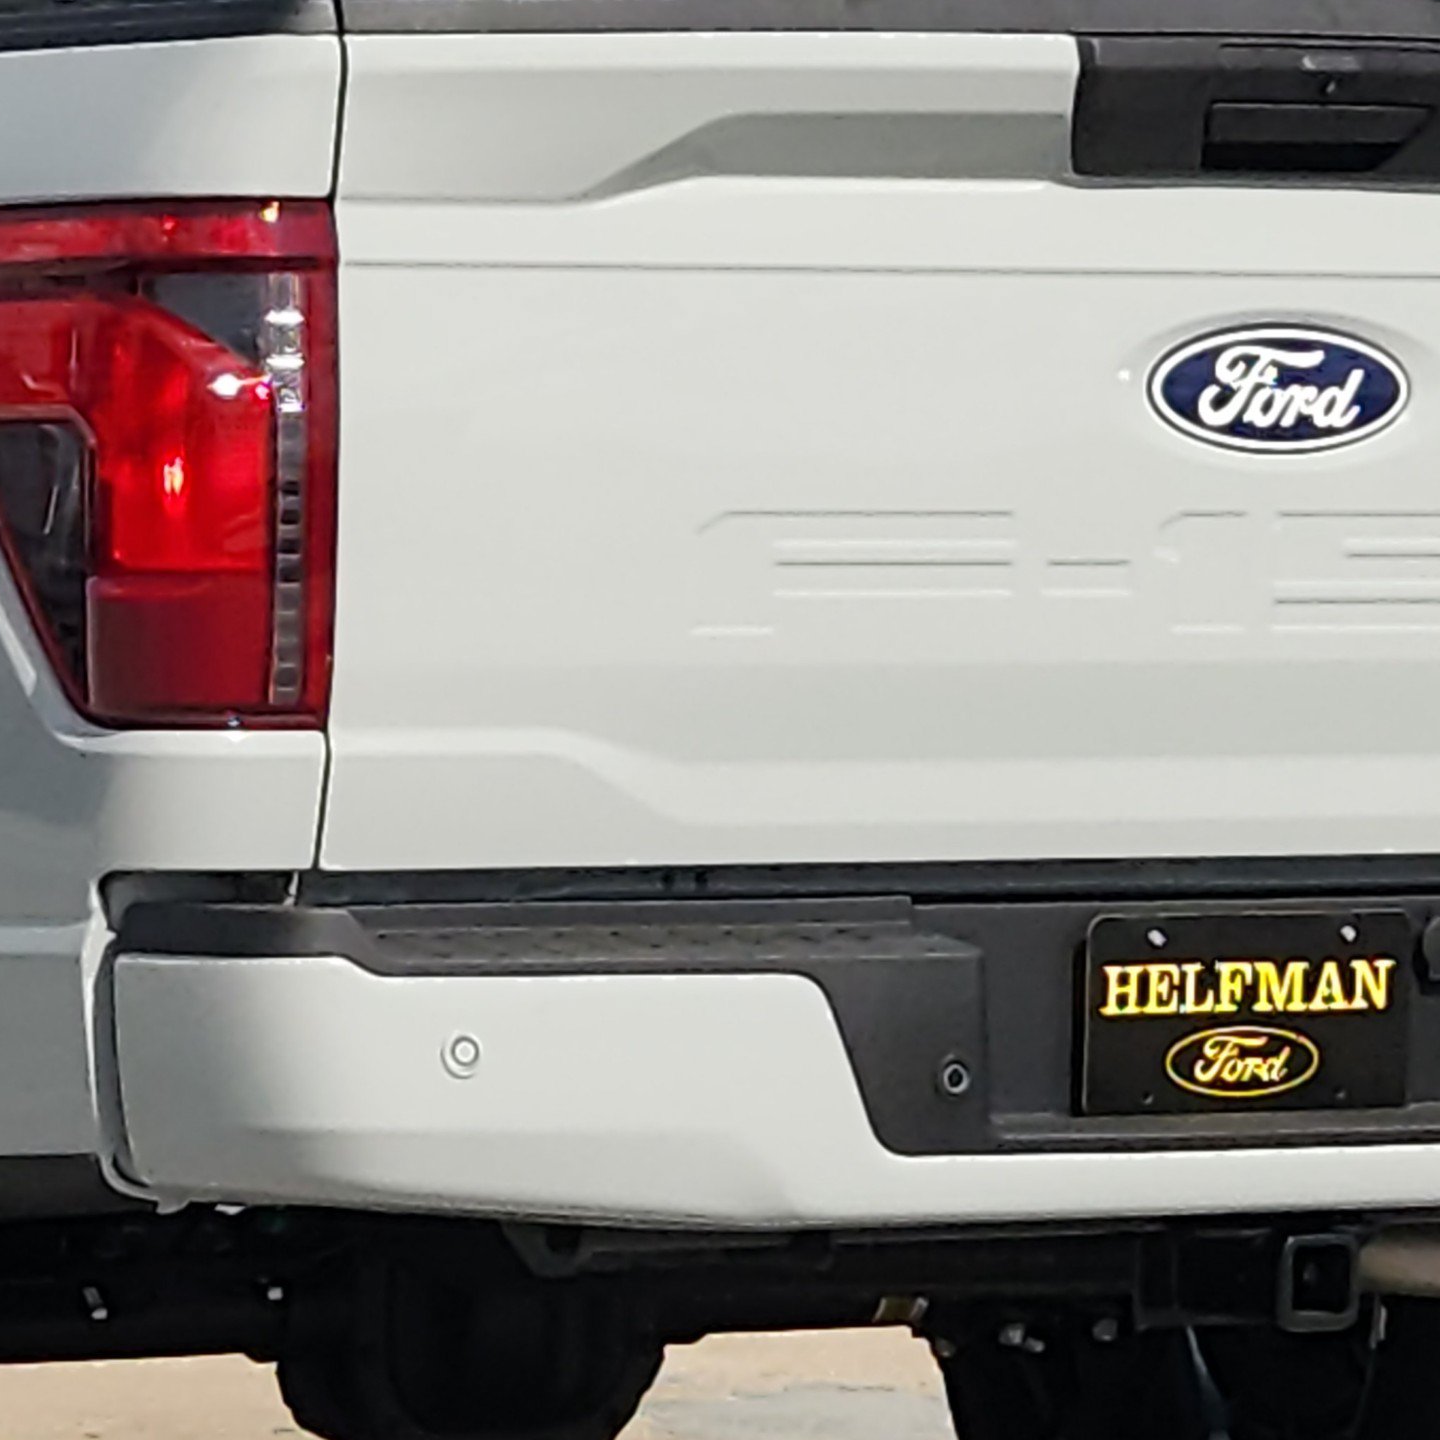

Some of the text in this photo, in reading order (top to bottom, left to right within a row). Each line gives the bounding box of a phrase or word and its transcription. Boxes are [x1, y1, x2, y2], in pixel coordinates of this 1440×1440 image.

[1197, 345, 1365, 428] Ford
[1098, 959, 1397, 1016] HELFMAN
[1193, 1035, 1291, 1082] Ford
